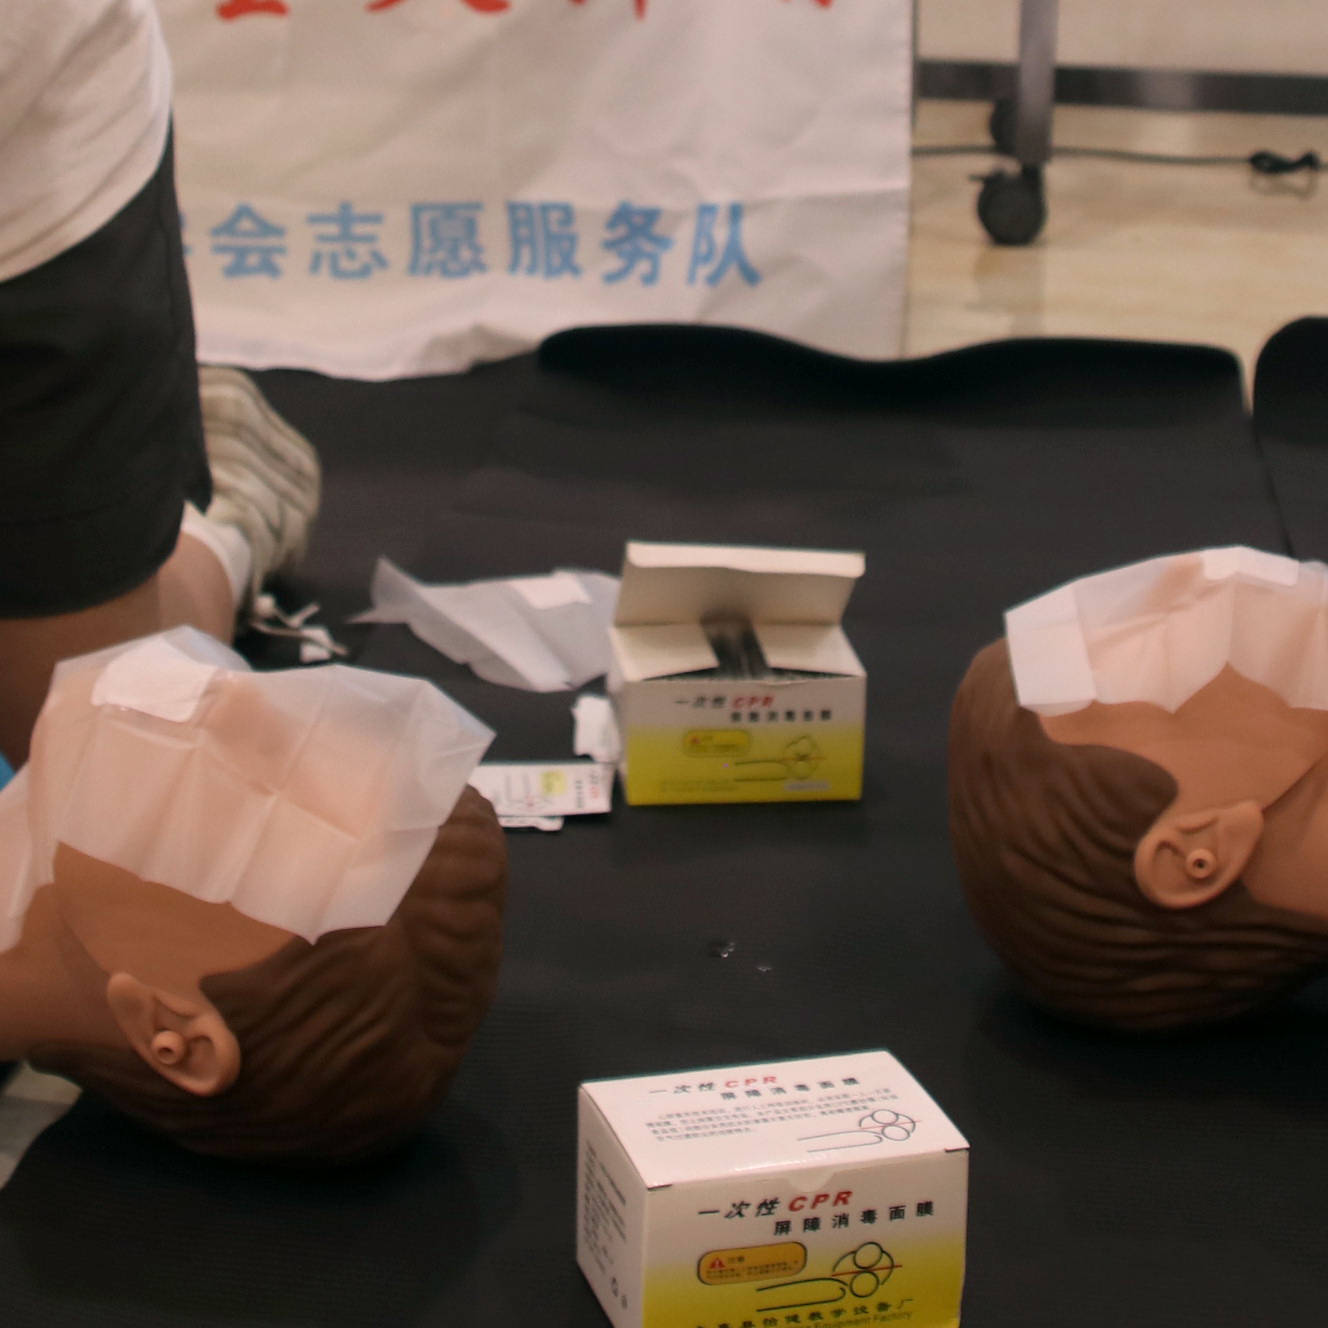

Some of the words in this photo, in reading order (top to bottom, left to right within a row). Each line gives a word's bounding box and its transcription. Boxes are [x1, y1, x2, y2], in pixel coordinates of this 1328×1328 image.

[178, 203, 763, 287] 会志愿服务队
[773, 1200, 935, 1236] 屏障消毒面膜
[788, 1190, 853, 1213] CPR
